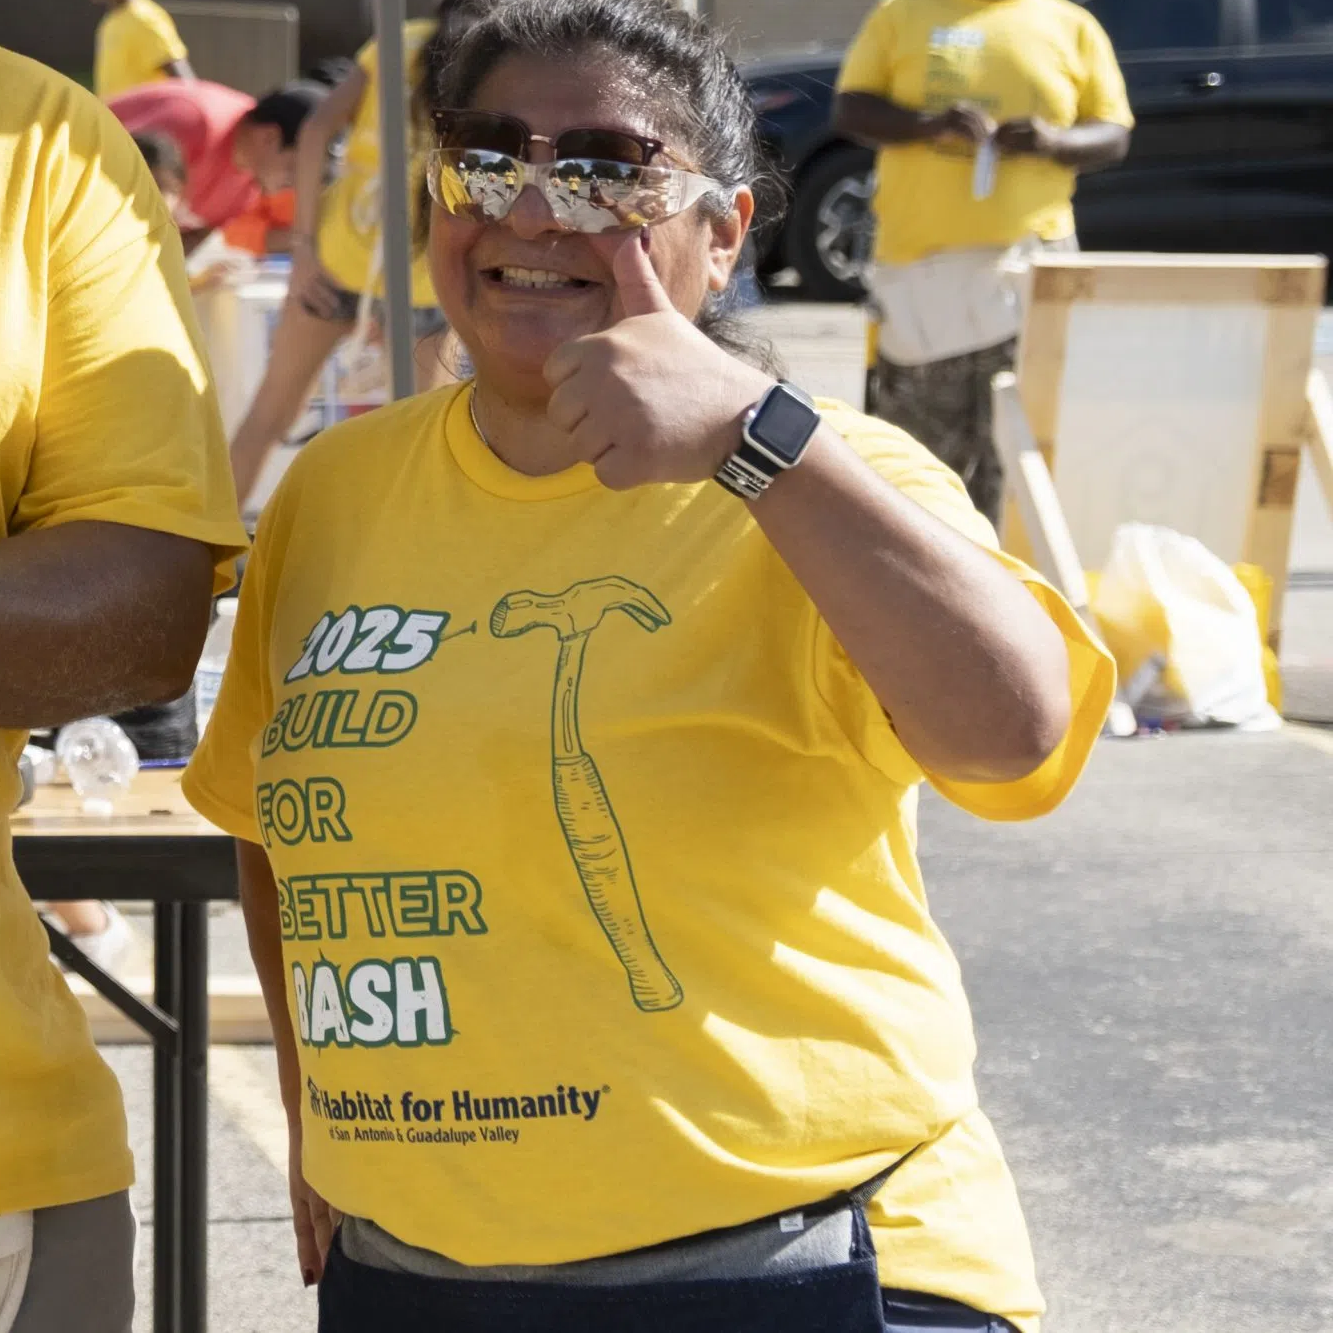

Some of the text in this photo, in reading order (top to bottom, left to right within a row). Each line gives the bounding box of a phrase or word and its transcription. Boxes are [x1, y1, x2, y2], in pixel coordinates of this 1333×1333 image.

[284, 604, 451, 684] 2025
[261, 690, 418, 757] BUILD
[256, 777, 353, 847] FOR
[278, 870, 488, 941] BETTER
[293, 957, 451, 1047] BASH
[320, 1090, 395, 1122] Habitat
[400, 1091, 445, 1122] for
[335, 1126, 350, 1142] San
[354, 1126, 395, 1143] Antonio
[396, 1128, 404, 1143] &
[407, 1127, 476, 1146] Guadalupe
[479, 1126, 520, 1144] Valley
